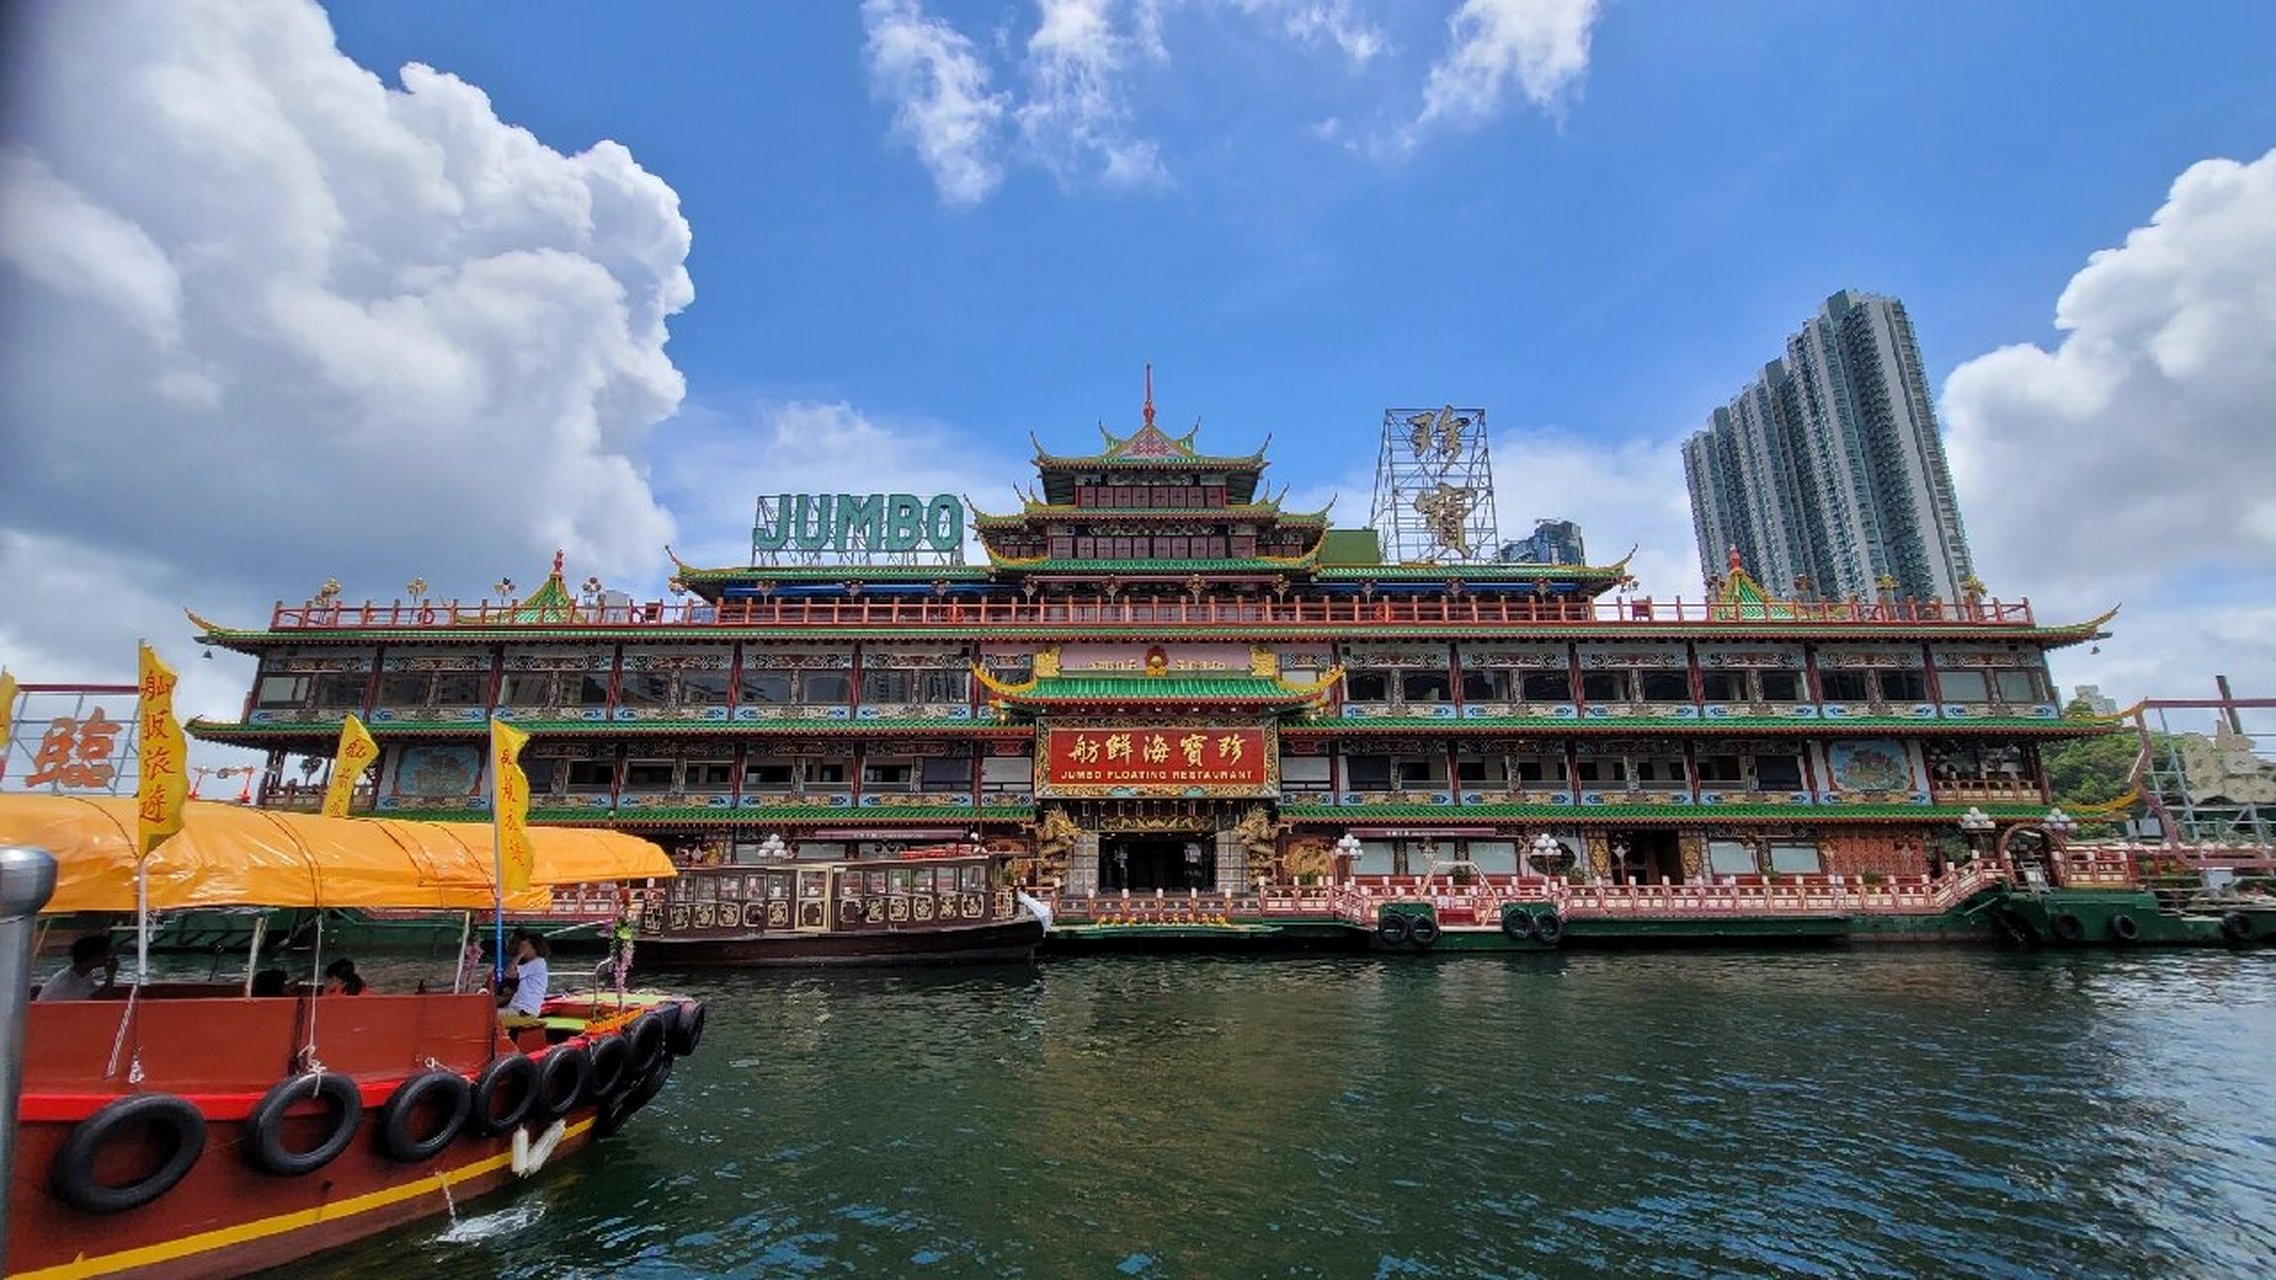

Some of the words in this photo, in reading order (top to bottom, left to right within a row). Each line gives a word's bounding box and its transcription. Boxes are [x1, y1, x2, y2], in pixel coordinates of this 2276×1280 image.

[753, 493, 964, 552] JUMBO
[1061, 770, 1102, 780] JUMBO
[1107, 770, 1167, 780] FLOATING
[1173, 770, 1253, 780] RESTAURANT
